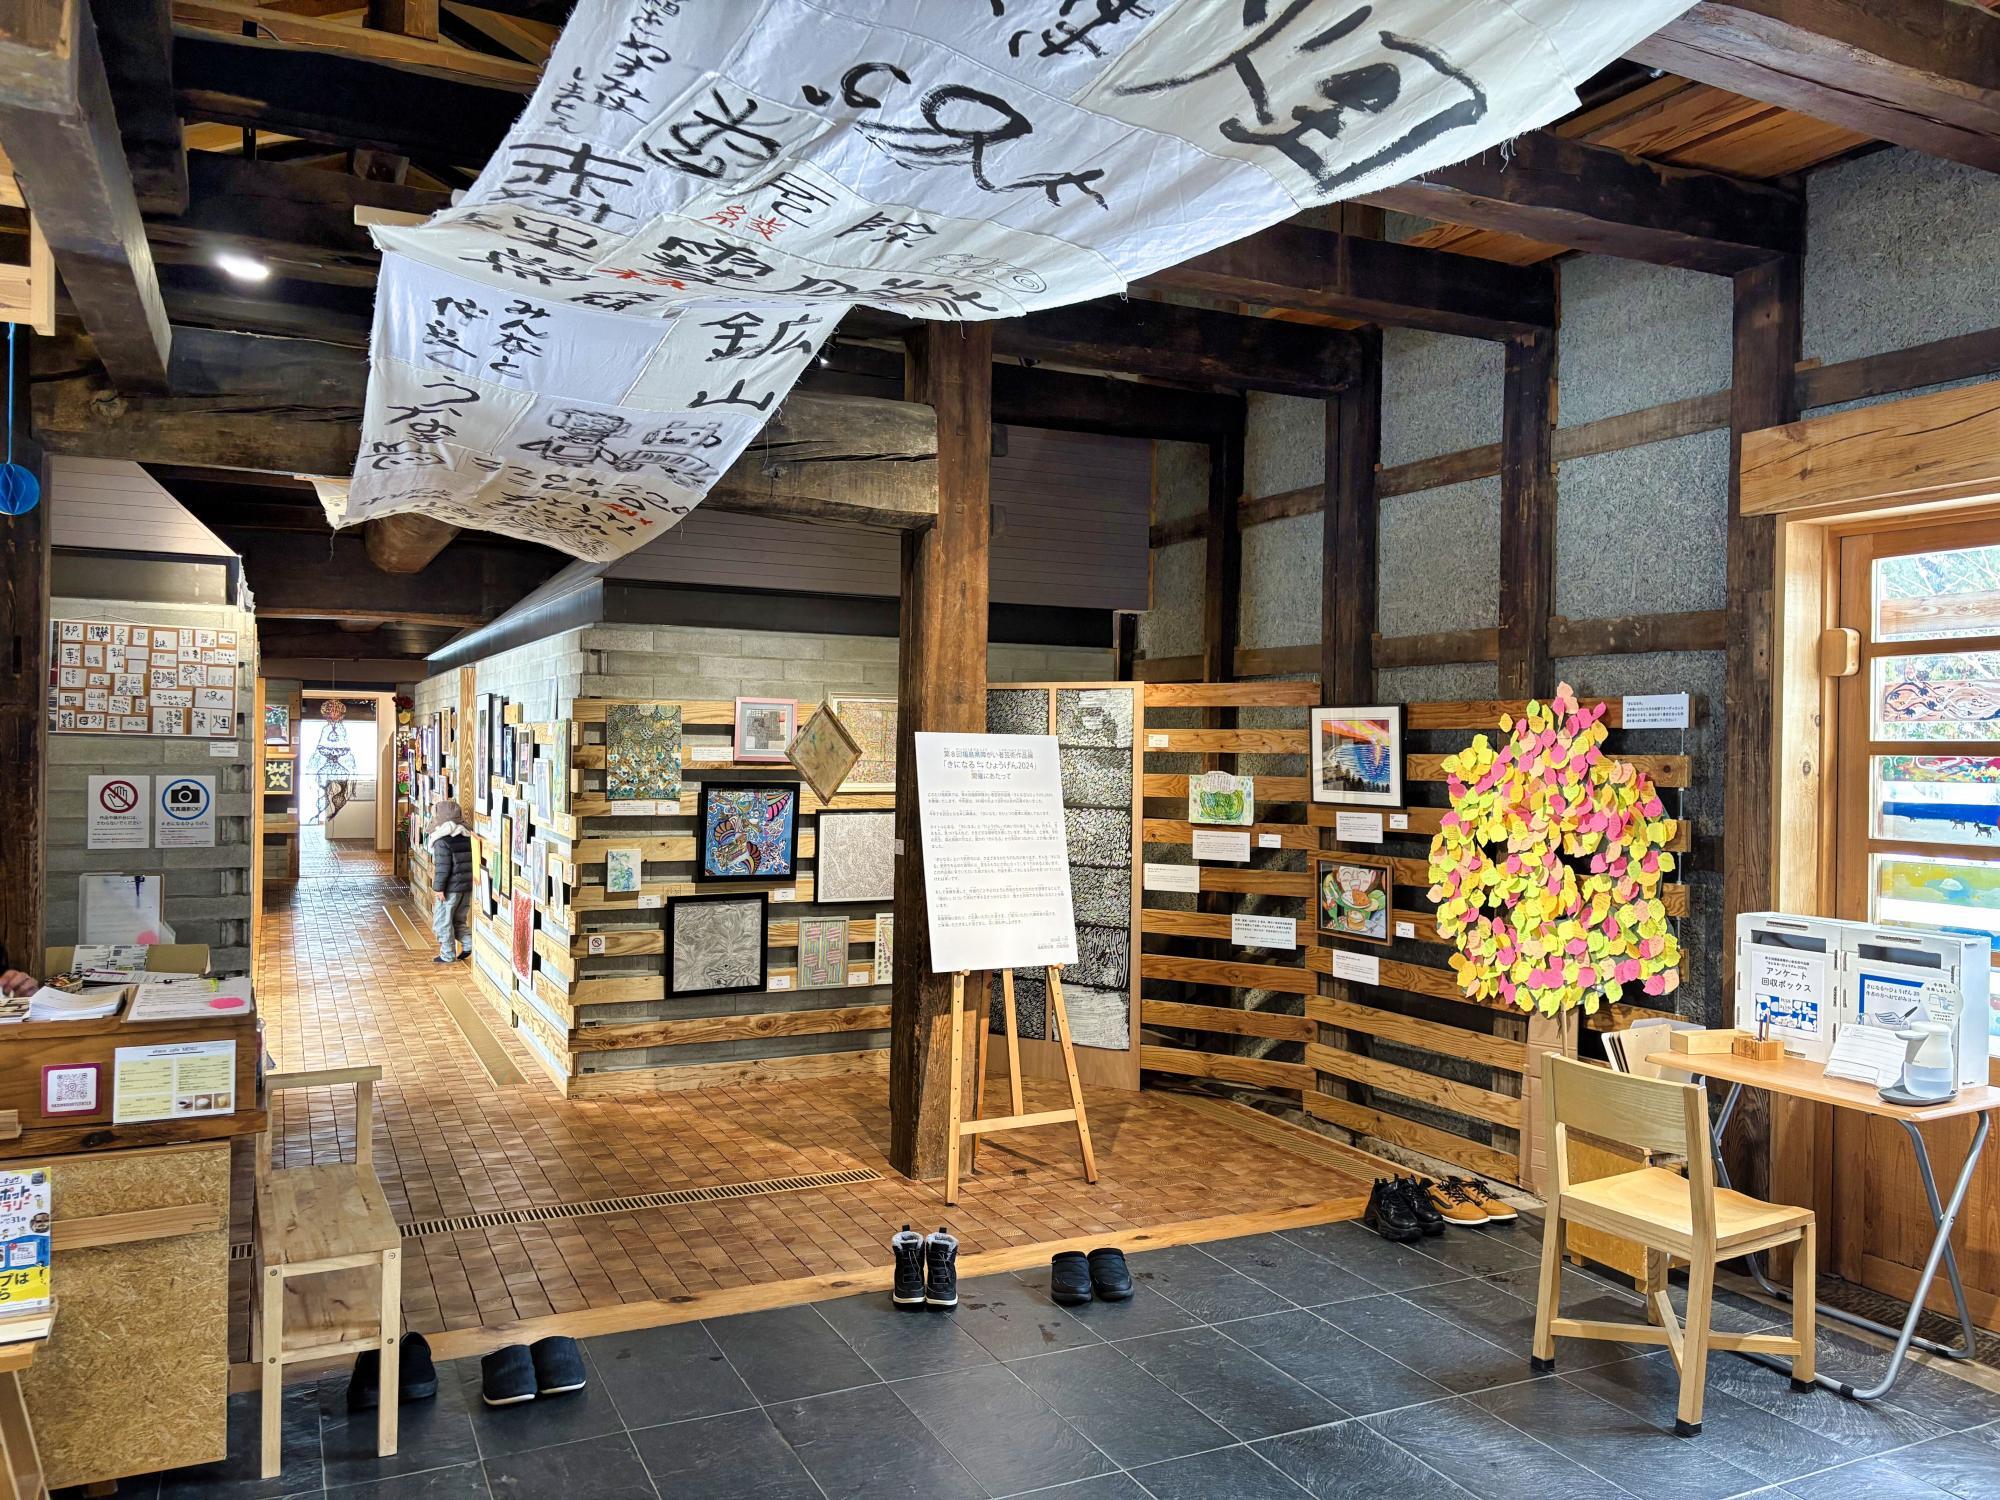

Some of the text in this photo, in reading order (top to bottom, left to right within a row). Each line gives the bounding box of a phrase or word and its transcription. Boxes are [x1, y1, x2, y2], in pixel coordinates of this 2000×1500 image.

[1766, 967, 1808, 981] アンケート
[1761, 977, 1812, 993] 回収ボックス
[0, 1185, 30, 1201] ポット
